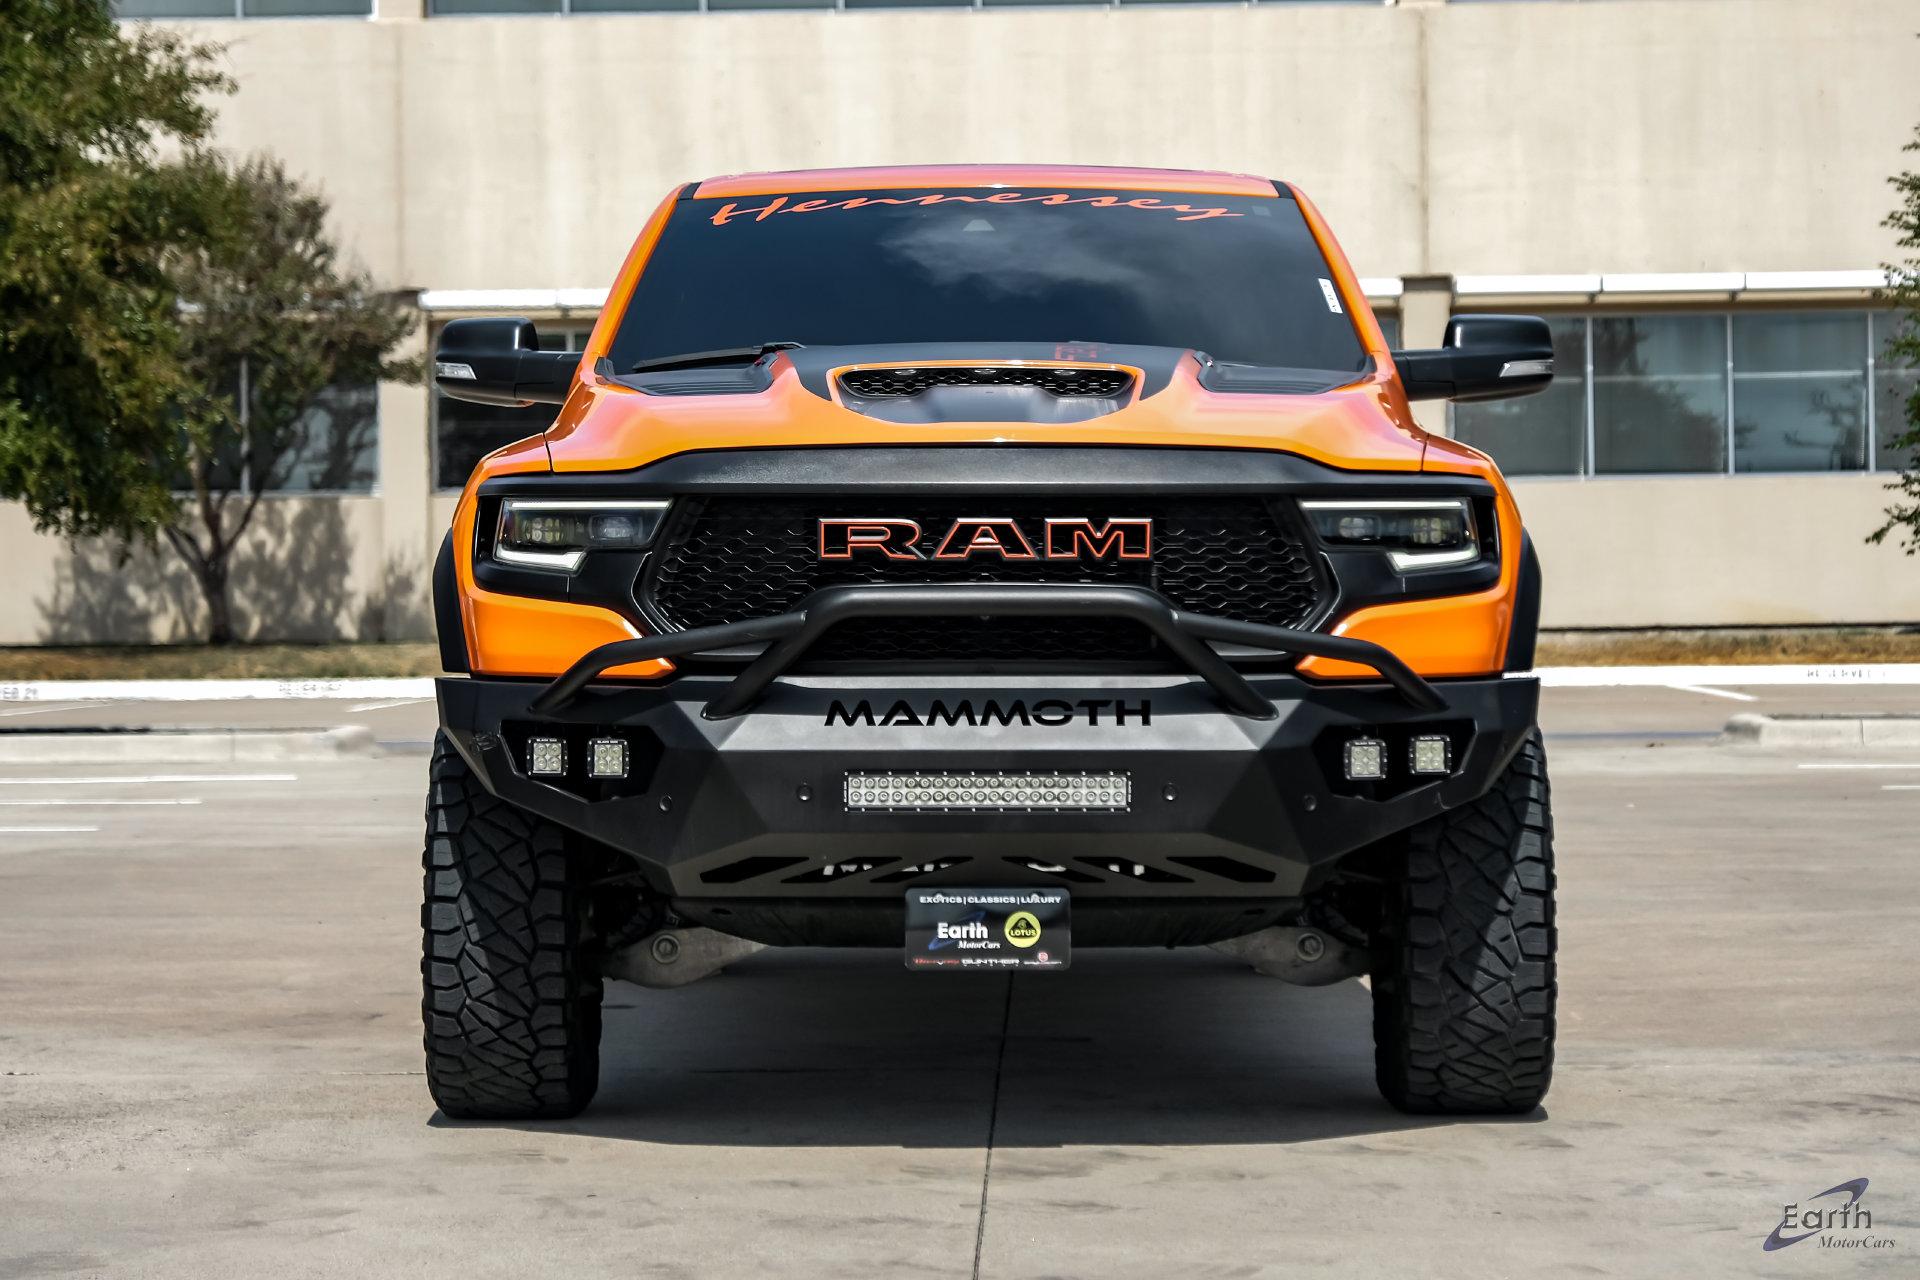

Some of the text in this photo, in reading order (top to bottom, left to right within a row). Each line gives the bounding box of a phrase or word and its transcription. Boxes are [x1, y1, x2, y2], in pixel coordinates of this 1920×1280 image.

[709, 193, 1244, 226] Hennessey
[817, 517, 1154, 560] RAM
[823, 699, 1152, 727] MAMMOTH
[937, 921, 989, 939] Earth
[1010, 929, 1038, 937] LOTUS
[957, 940, 1001, 949] MotorCars
